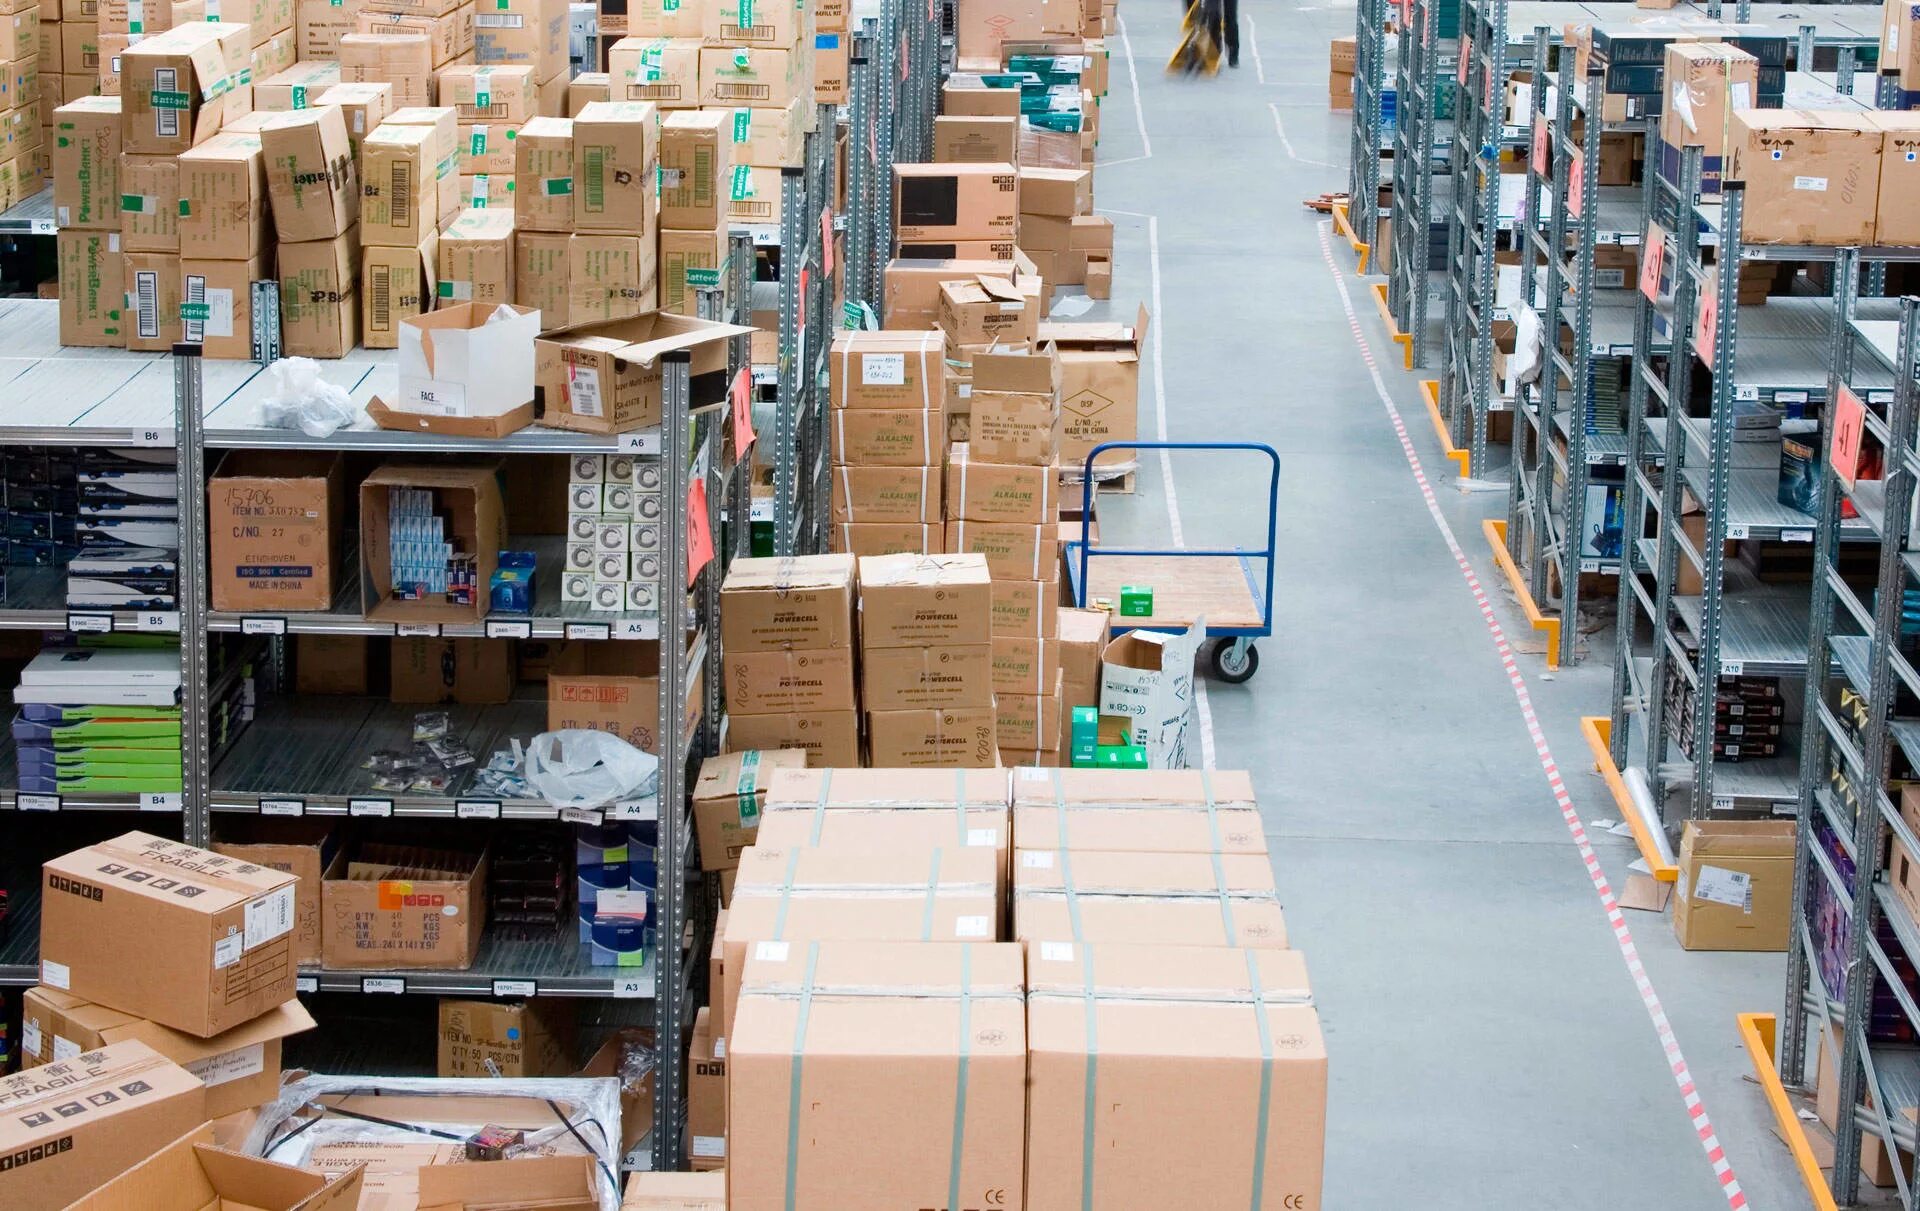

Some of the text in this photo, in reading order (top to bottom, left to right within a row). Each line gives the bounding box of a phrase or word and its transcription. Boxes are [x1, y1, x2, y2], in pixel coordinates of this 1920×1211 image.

[1750, 249, 1760, 257] A7
[420, 391, 434, 402] FACE
[1091, 426, 1108, 434] CHINA
[145, 432, 158, 440] B6
[631, 439, 644, 447] A6
[994, 491, 1033, 499] ALKALINE
[232, 507, 250, 516] ITEM
[233, 527, 284, 537] C/NO. 27
[249, 581, 302, 590] MADE IN CHINA
[149, 617, 163, 625] B5
[628, 625, 642, 633] A5
[1725, 665, 1739, 673] A10
[588, 721, 597, 729] 20
[606, 721, 620, 730] PCS
[152, 796, 165, 804] B4
[627, 806, 641, 814] A4
[140, 850, 231, 878] FRAGILE
[423, 913, 440, 921] PCS
[423, 922, 440, 931] KGS
[423, 932, 440, 940] KGS
[625, 982, 638, 992] A3
[622, 1157, 635, 1165] A2
[986, 1189, 1004, 1204] CE
[1284, 1194, 1304, 1209] CE
